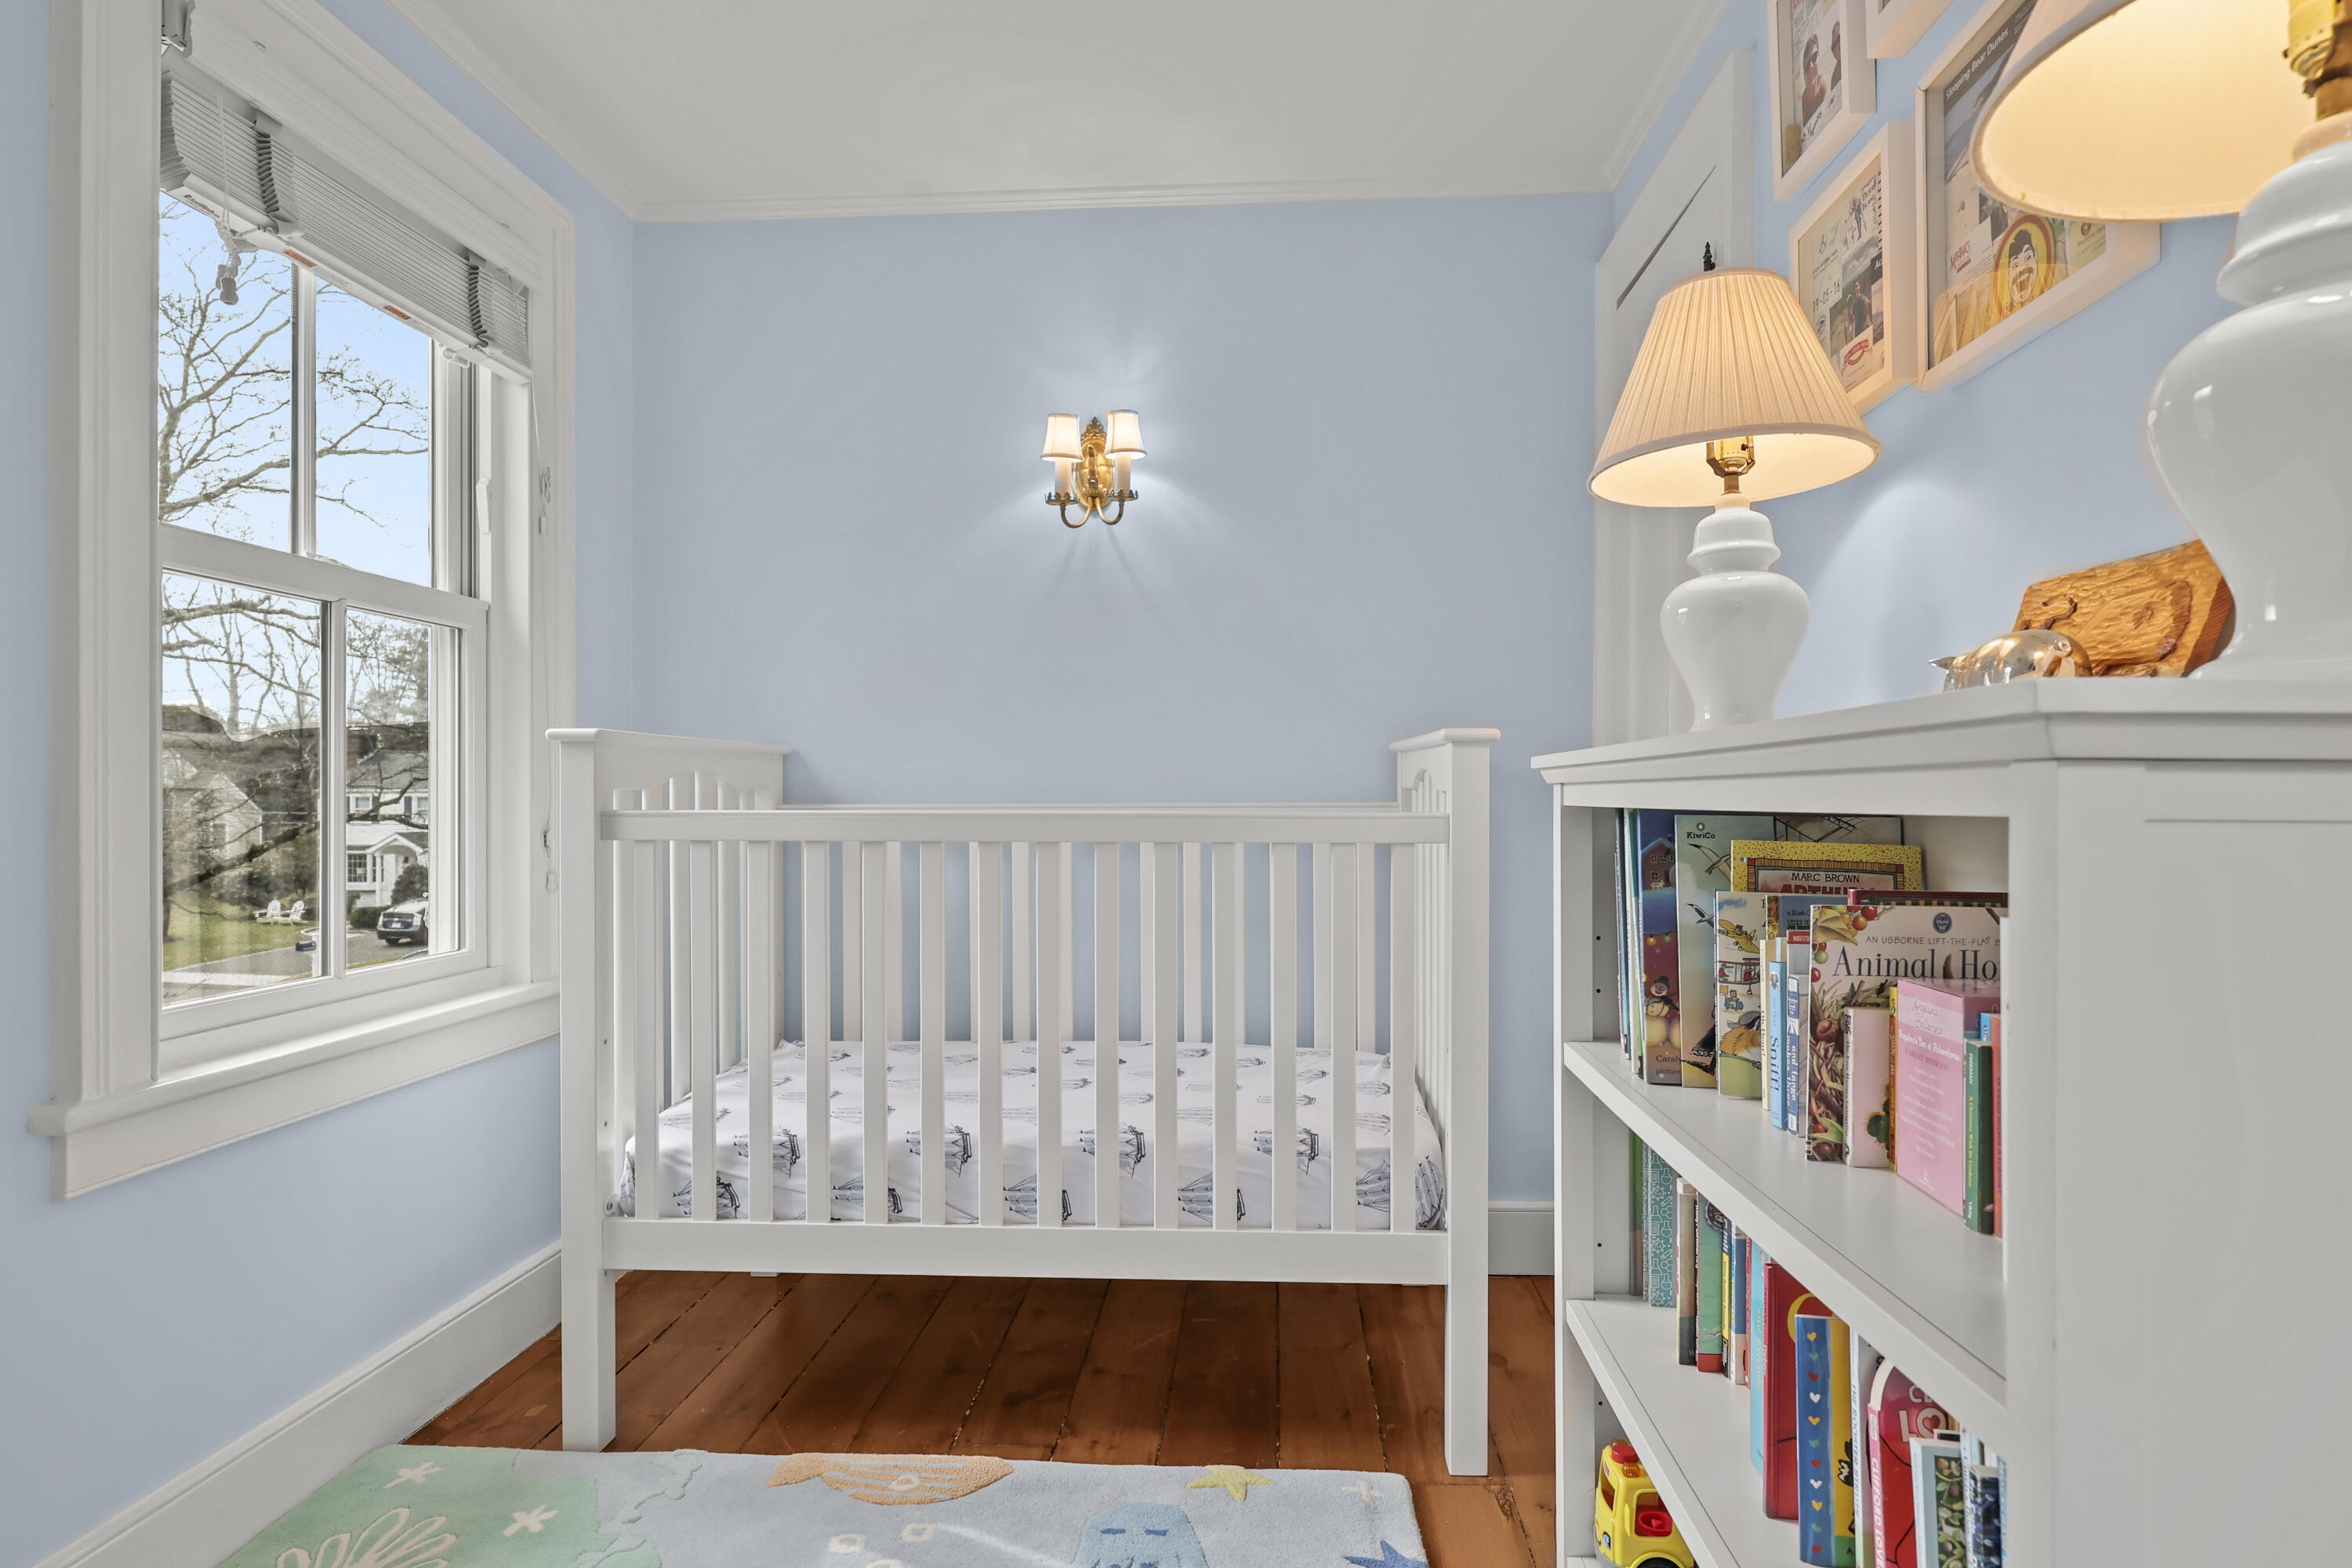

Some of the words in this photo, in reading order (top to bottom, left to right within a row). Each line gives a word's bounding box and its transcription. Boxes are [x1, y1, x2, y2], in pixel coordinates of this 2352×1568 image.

[1945, 68, 1970, 100] Sleeping
[1972, 51, 1986, 73] Bear
[1987, 27, 2009, 56] Dunes
[1791, 873, 1820, 882] MARC
[1825, 873, 1860, 883] BROWN
[1882, 936, 1925, 945] USBORNE
[1928, 936, 1991, 946] LIFT-THE-FLAP
[1831, 945, 1937, 978] Animal
[1958, 949, 2001, 979] Ho
[1769, 1035, 1780, 1091] Sniff!
[1871, 1457, 1882, 1526] CLIFFORD
[1873, 1528, 1885, 1568] LOVE
